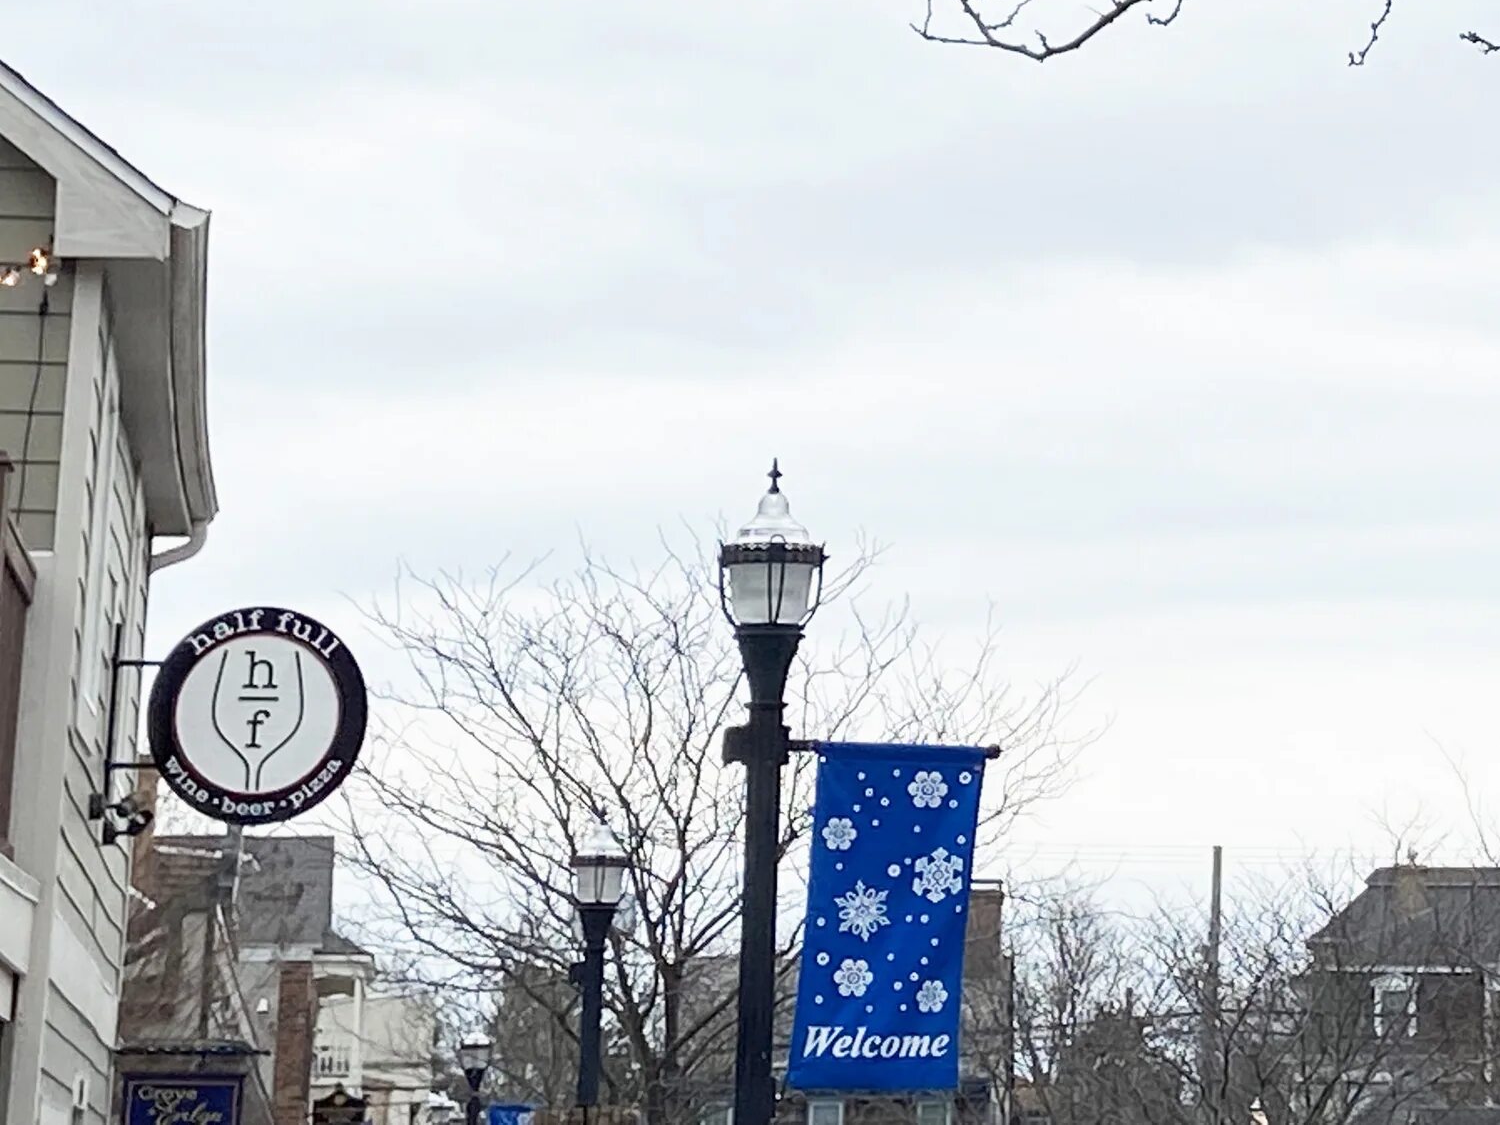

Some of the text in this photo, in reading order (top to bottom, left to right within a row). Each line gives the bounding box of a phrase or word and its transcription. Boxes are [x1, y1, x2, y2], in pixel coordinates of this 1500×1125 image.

[186, 609, 341, 659] half full
[242, 650, 278, 689] h
[244, 709, 271, 748] f
[165, 755, 343, 816] wine beer pizza
[802, 1025, 950, 1058] Welcome
